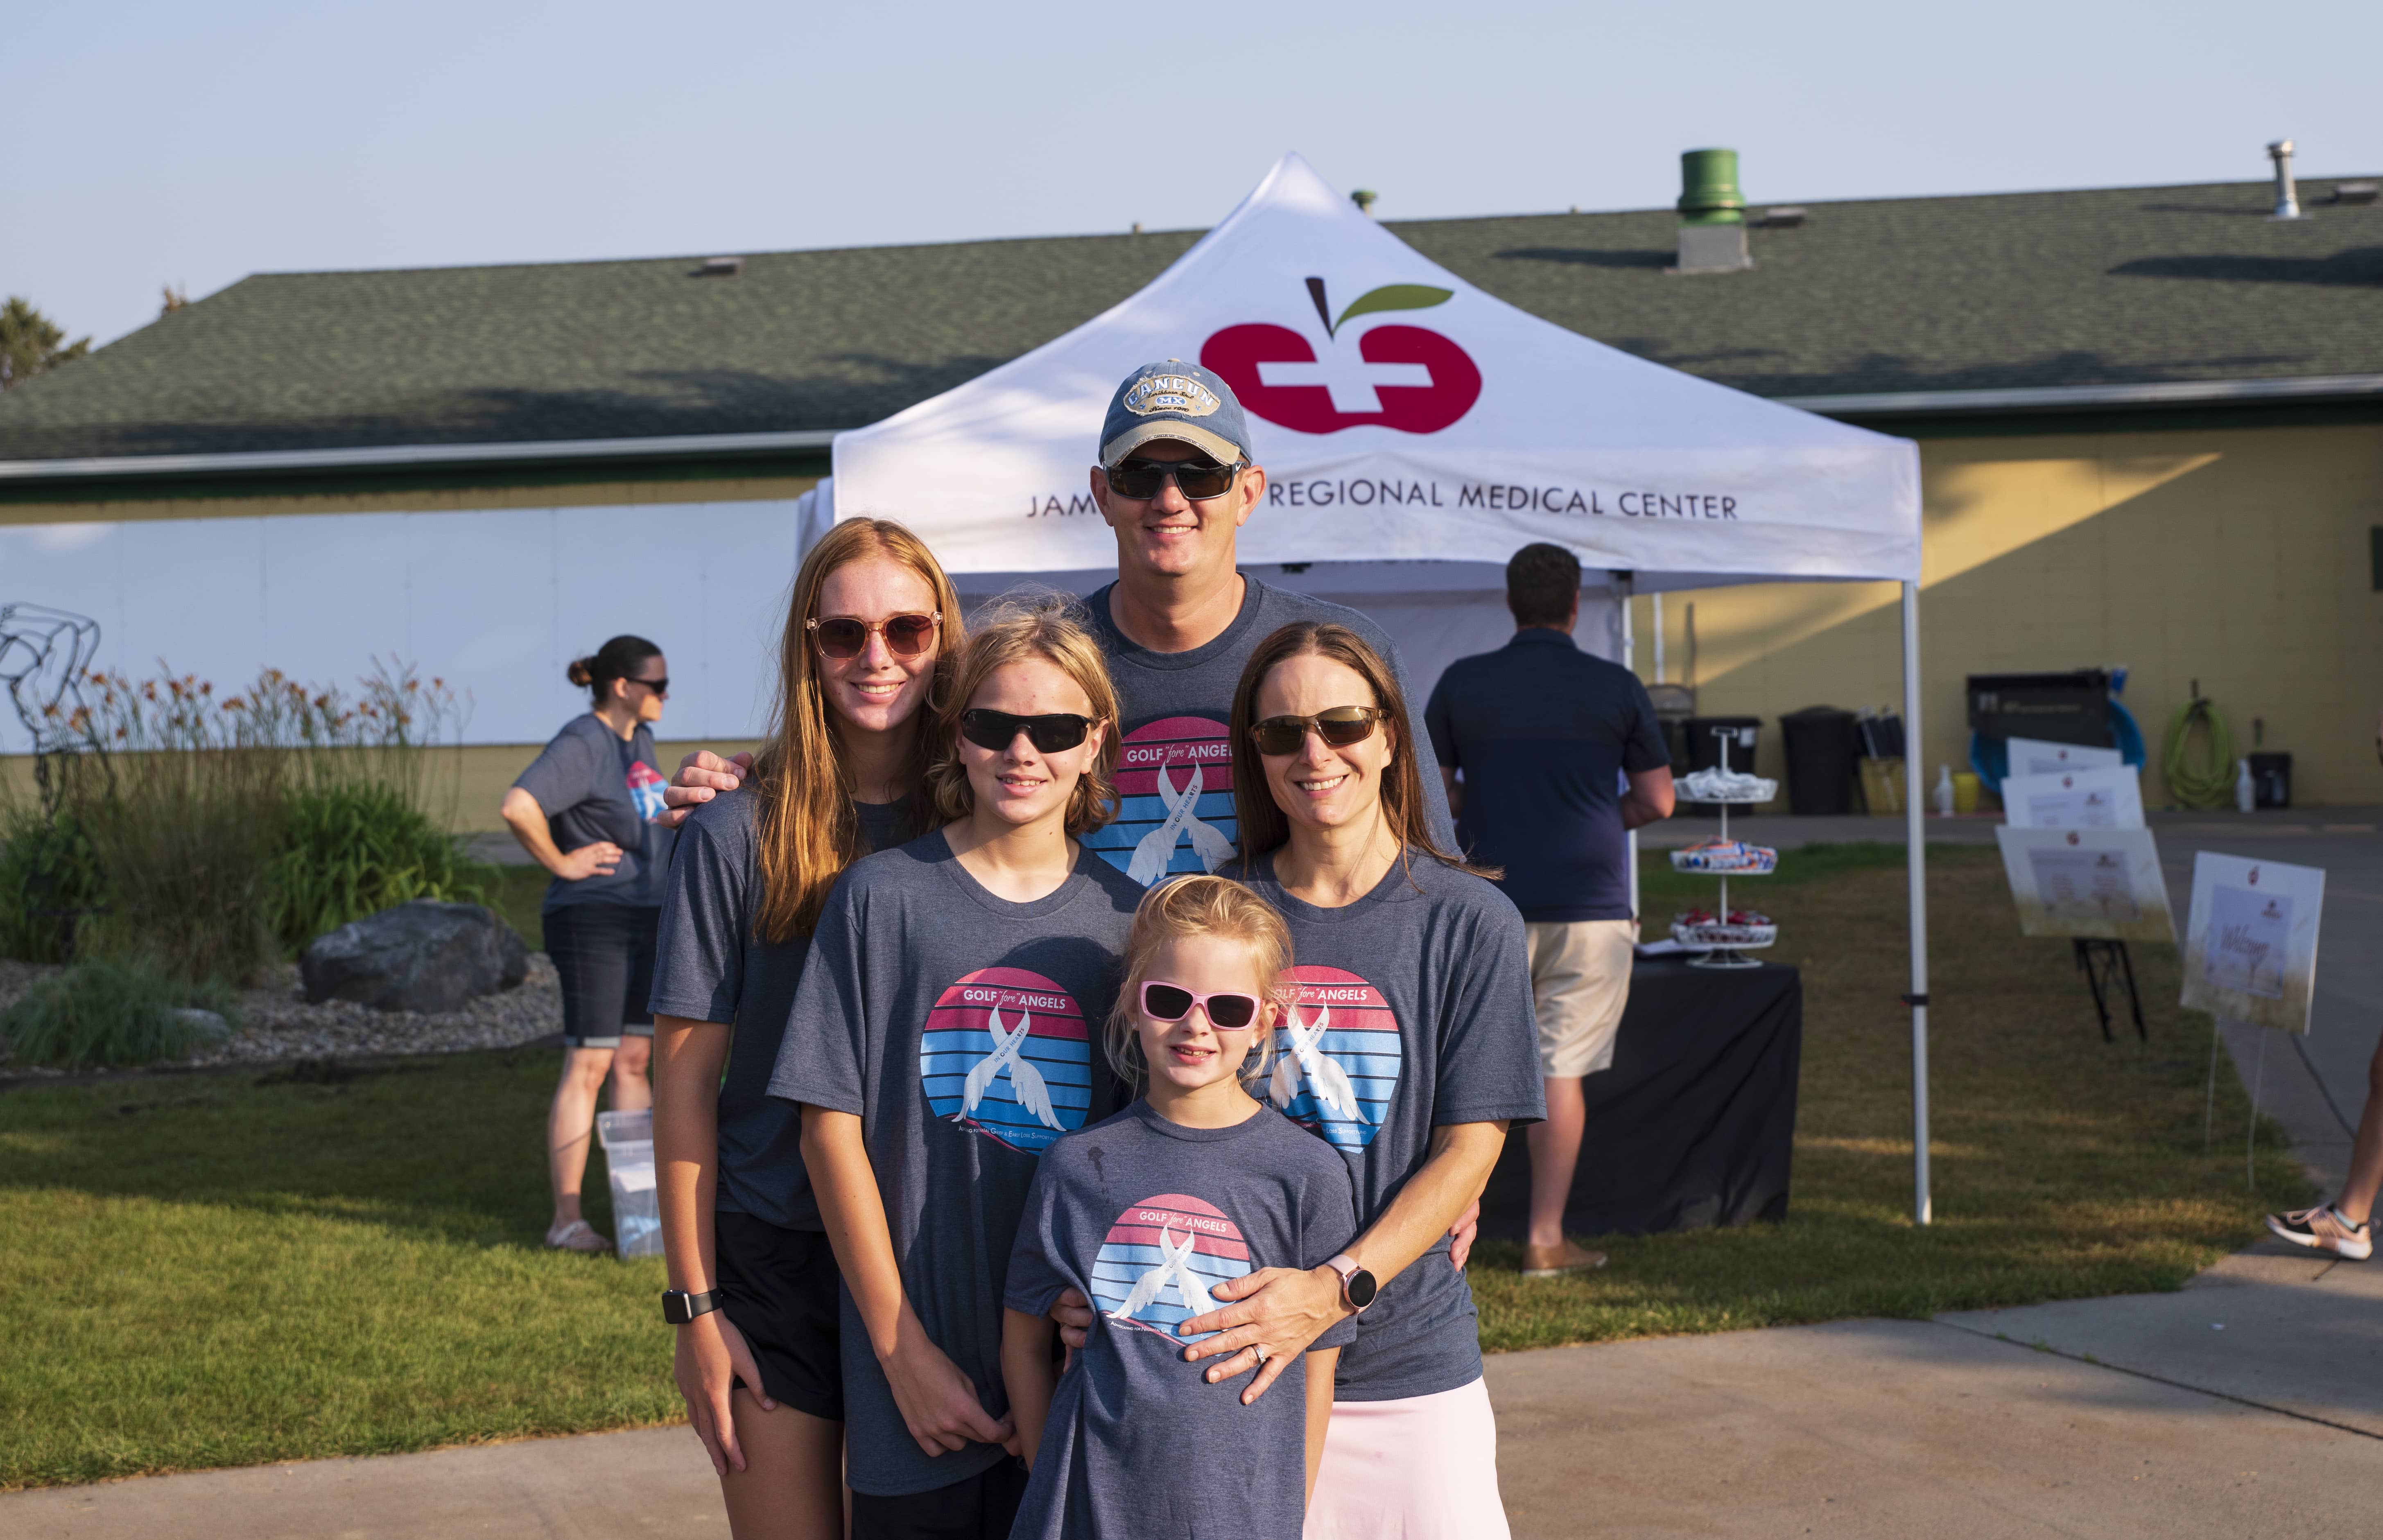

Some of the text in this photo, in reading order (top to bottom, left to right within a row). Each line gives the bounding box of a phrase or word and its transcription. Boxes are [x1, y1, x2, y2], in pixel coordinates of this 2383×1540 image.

[1128, 377, 1214, 406] CANCUN
[1148, 390, 1194, 400] Caribbean Soul
[1027, 479, 1738, 519] JAM REGIONAL MEDICAL CENTER
[1127, 748, 1163, 762] GOLF
[1188, 744, 1232, 759] ANGEL
[1170, 784, 1198, 831] IN OUR HEARTS
[963, 989, 997, 1002] GOLF
[1018, 994, 1066, 1009] ANGELS
[1272, 989, 1296, 999] OLF
[1317, 989, 1367, 1000] ANGELS
[1000, 1046, 1011, 1057] OUR
[1009, 1027, 1024, 1047] HEARTS
[1308, 1022, 1323, 1042] HEARTS
[1139, 1211, 1167, 1222] GOLF
[1185, 1217, 1227, 1233] ANGELS
[1110, 1321, 1134, 1330] ADVOCATING
